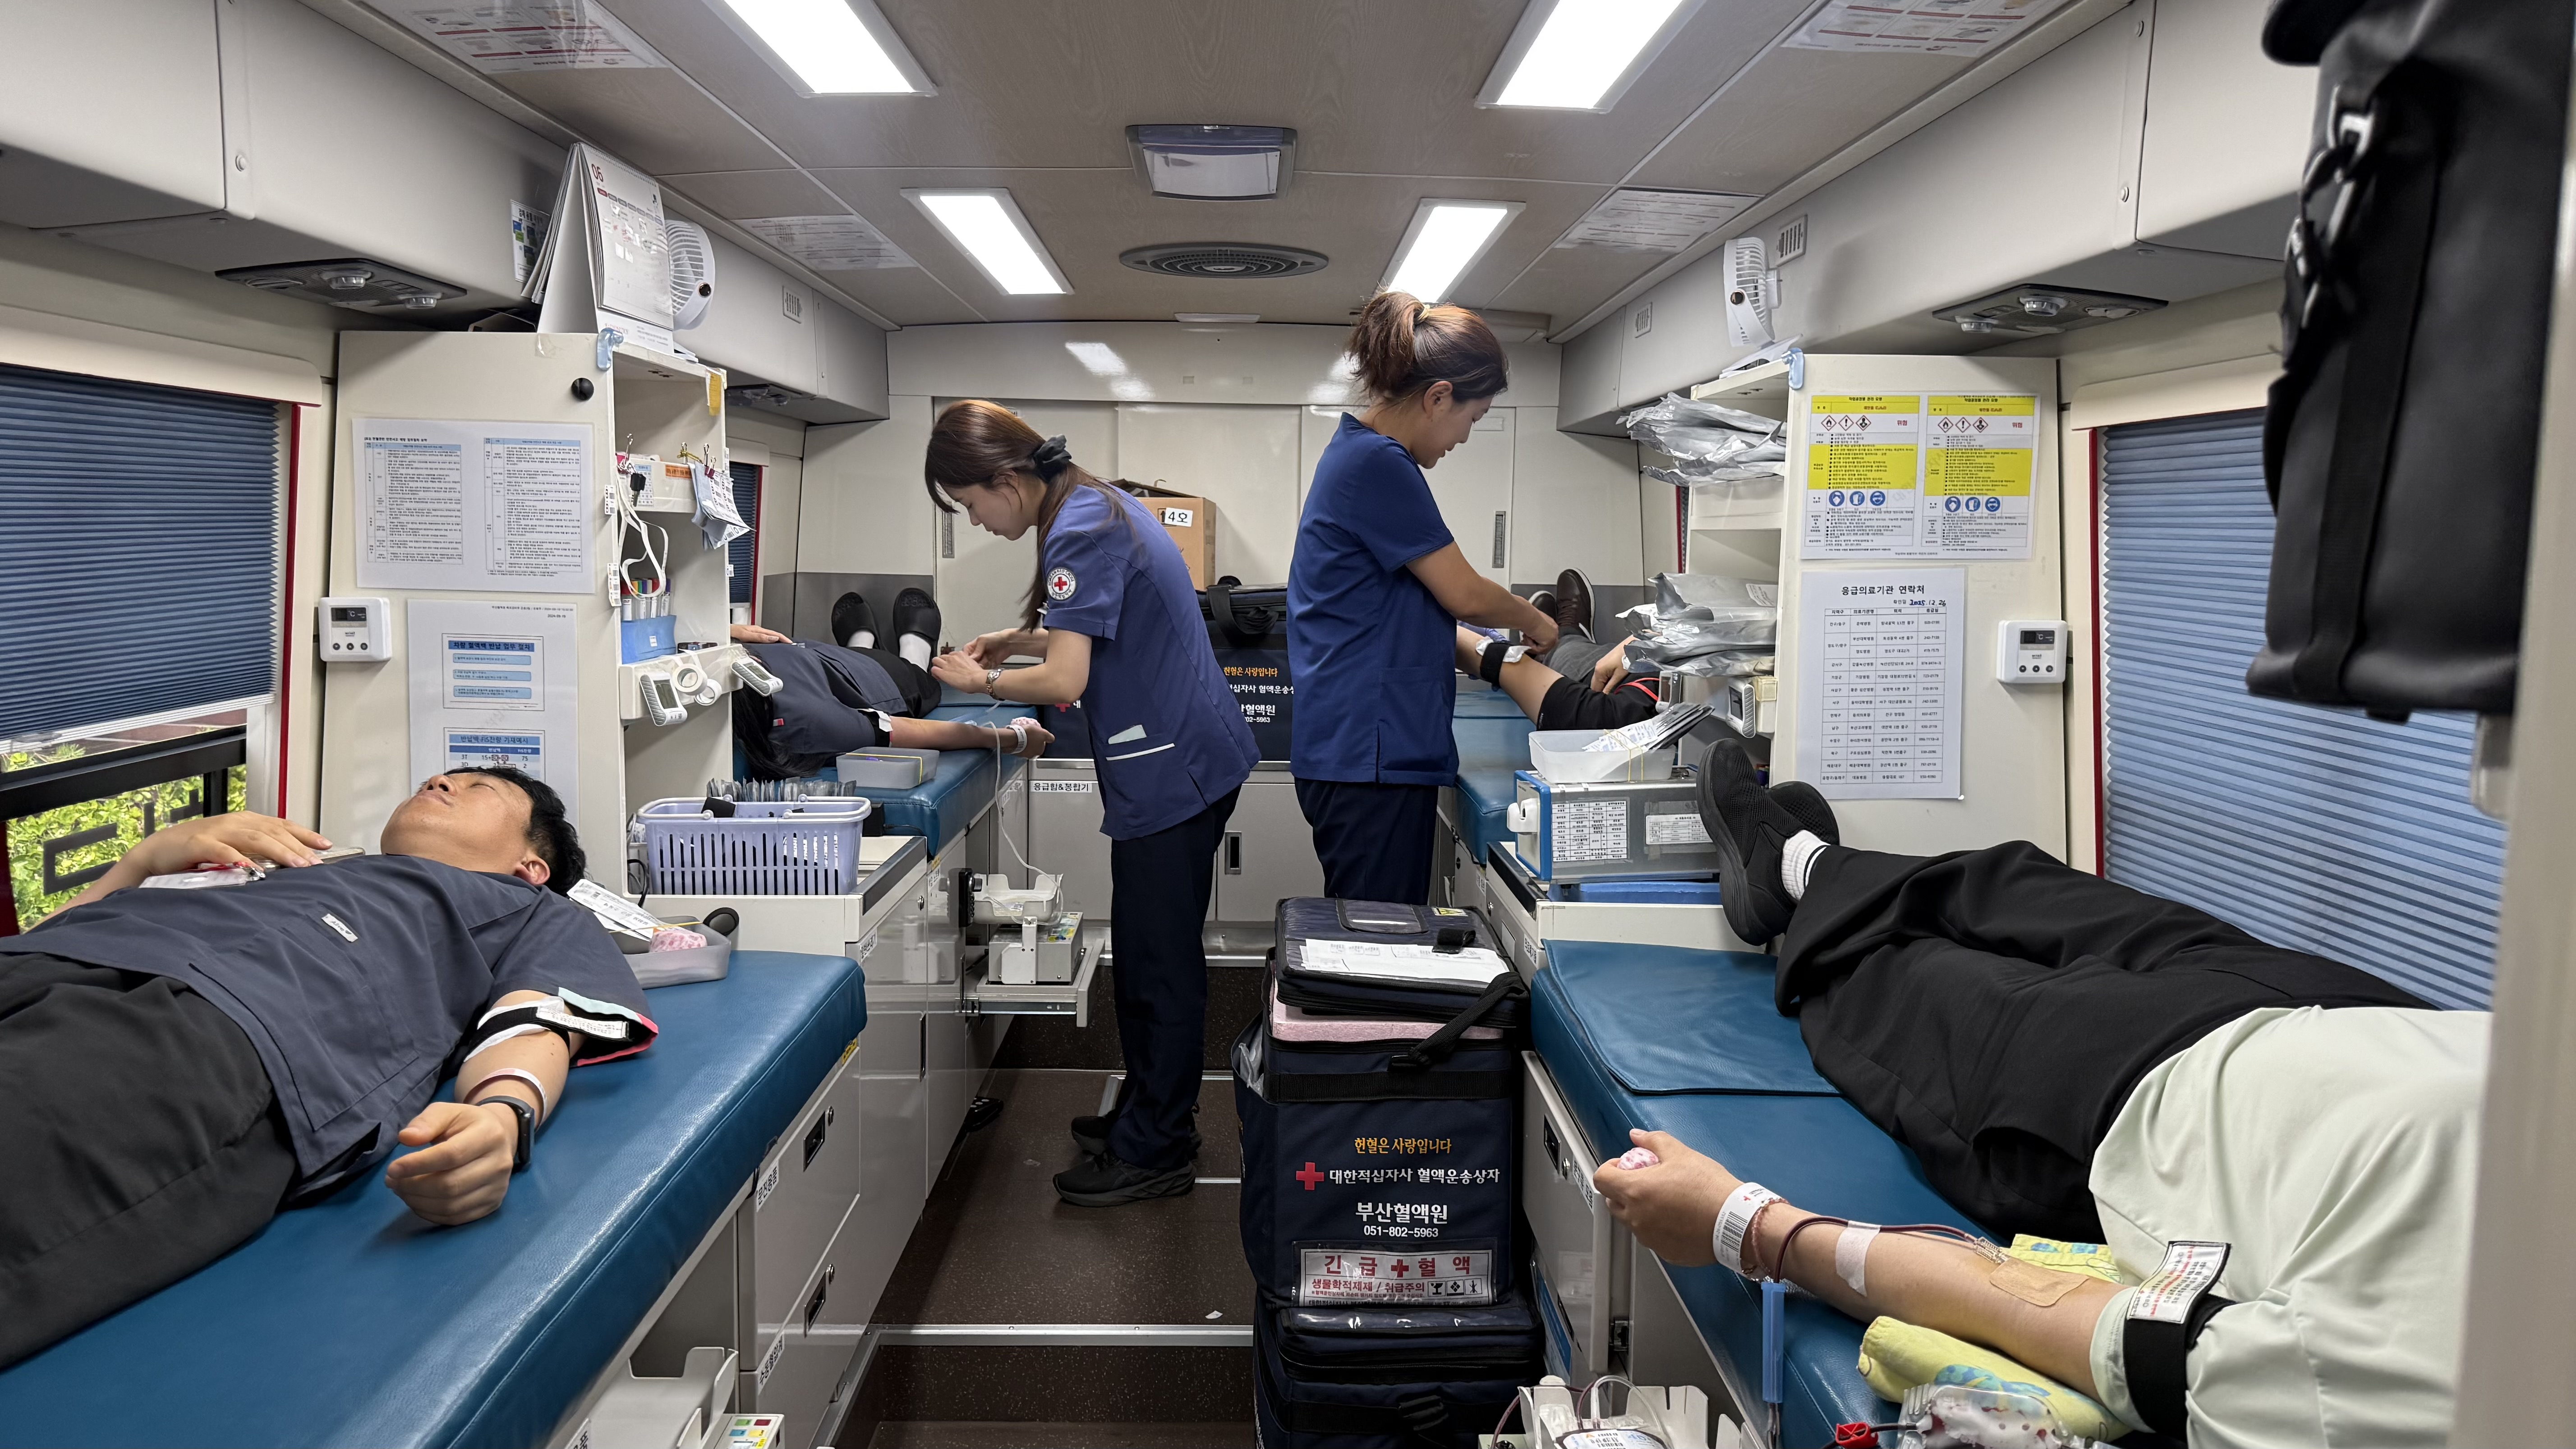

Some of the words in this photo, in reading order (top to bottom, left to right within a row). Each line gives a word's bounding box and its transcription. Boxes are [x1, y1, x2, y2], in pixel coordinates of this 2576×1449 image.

[591, 163, 603, 182] 06
[1841, 586, 1894, 595] 응급의료기관
[1899, 585, 1925, 594] 연락처
[1354, 1137, 1390, 1154] 헌혈은
[1391, 1137, 1452, 1155] 사랑입니다
[1329, 1168, 1413, 1184] 대한적십자사
[1417, 1168, 1500, 1185] 혈액운송상자
[1355, 1202, 1448, 1224] 부산혈액원
[1364, 1225, 1439, 1238] 051-802-5963
[1312, 1278, 1372, 1293] 생물학적제제
[1385, 1282, 1425, 1293] 취급주의
